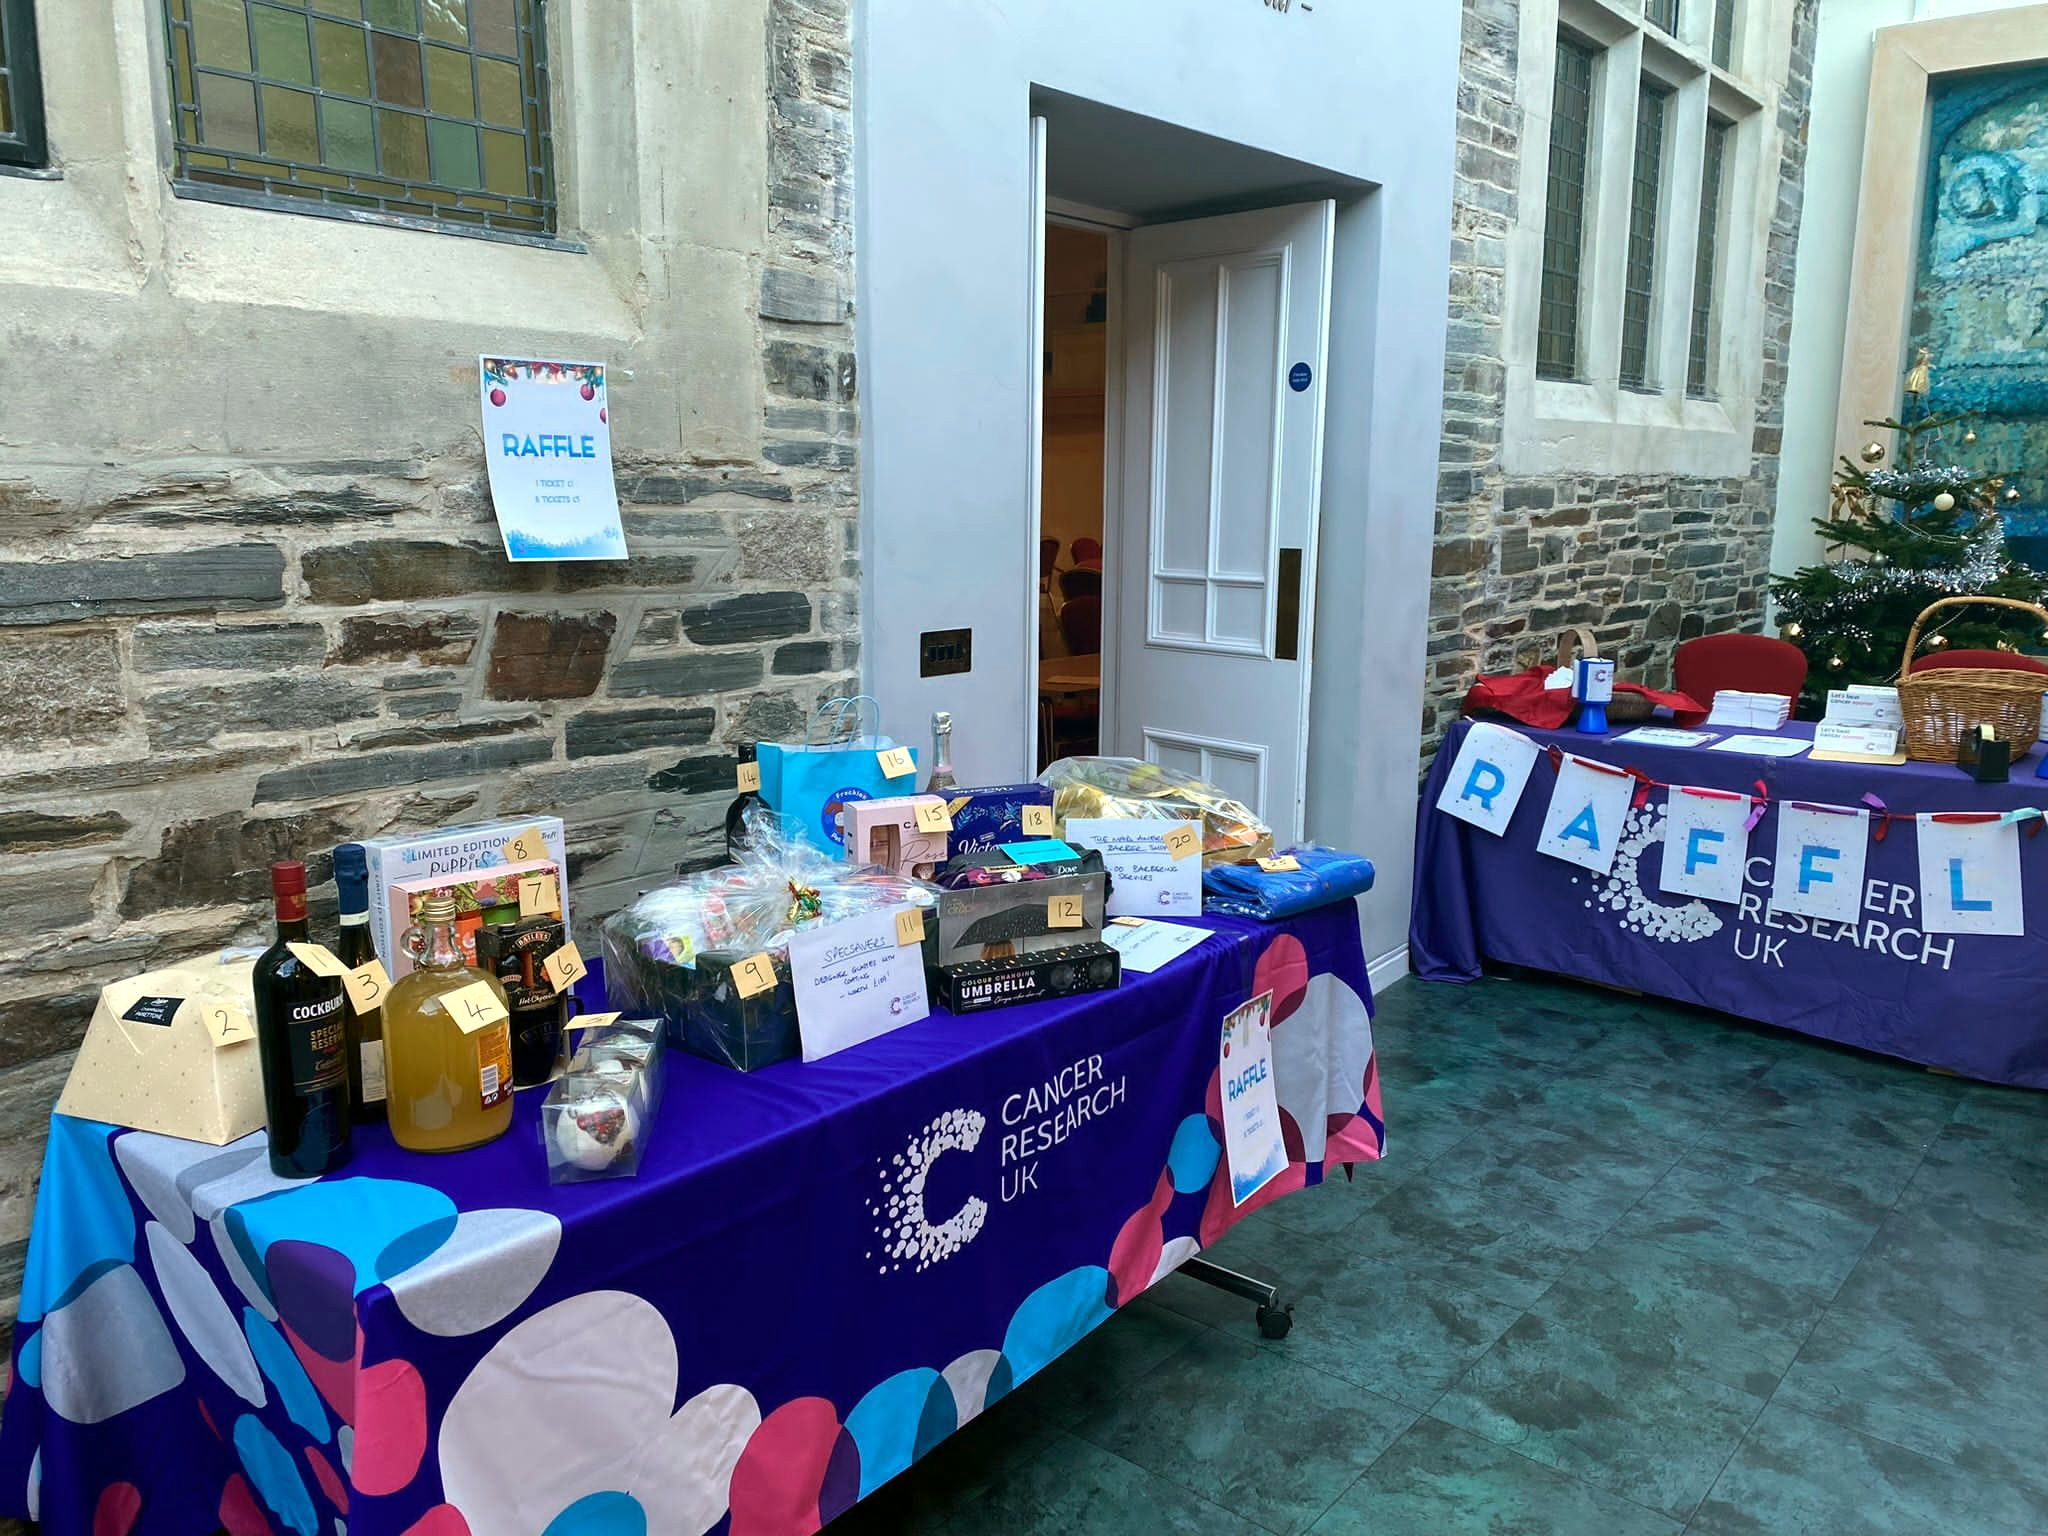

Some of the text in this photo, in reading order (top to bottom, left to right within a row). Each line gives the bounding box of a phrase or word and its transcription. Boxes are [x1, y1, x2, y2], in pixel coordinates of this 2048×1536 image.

[502, 433, 596, 459] RAFFLE
[540, 480, 565, 488] TICKET
[542, 495, 571, 504] TICKETS
[886, 754, 905, 768] 16
[742, 770, 757, 785] 14
[924, 805, 943, 822] 15
[1029, 811, 1042, 826] 18
[903, 821, 920, 831] CA
[1460, 758, 1993, 911] R A F F L
[411, 836, 511, 862] LIMITED EDITION
[513, 839, 528, 860] 8
[1170, 834, 1191, 849] 20
[1057, 865, 1078, 875] Dove
[527, 882, 542, 908] 7
[1744, 856, 1916, 919] CER
[1058, 902, 1081, 919] 12
[902, 917, 915, 933] 11
[516, 930, 550, 948] BAILEYS
[823, 936, 886, 963] SPECSAVERS
[1734, 928, 1787, 968] UK
[557, 955, 576, 979] 6
[745, 961, 765, 984] 9
[961, 969, 1035, 987] COLOUR CHANGING
[356, 973, 380, 1001] 3
[961, 976, 1036, 999] UMBRELLA
[463, 999, 492, 1021] 4
[215, 1009, 241, 1036] 2
[1001, 1054, 1103, 1126] CANCER
[1227, 1057, 1267, 1102] RAFFLE
[1001, 1075, 1126, 1167] RESEARCH
[1001, 1161, 1039, 1202] UK
